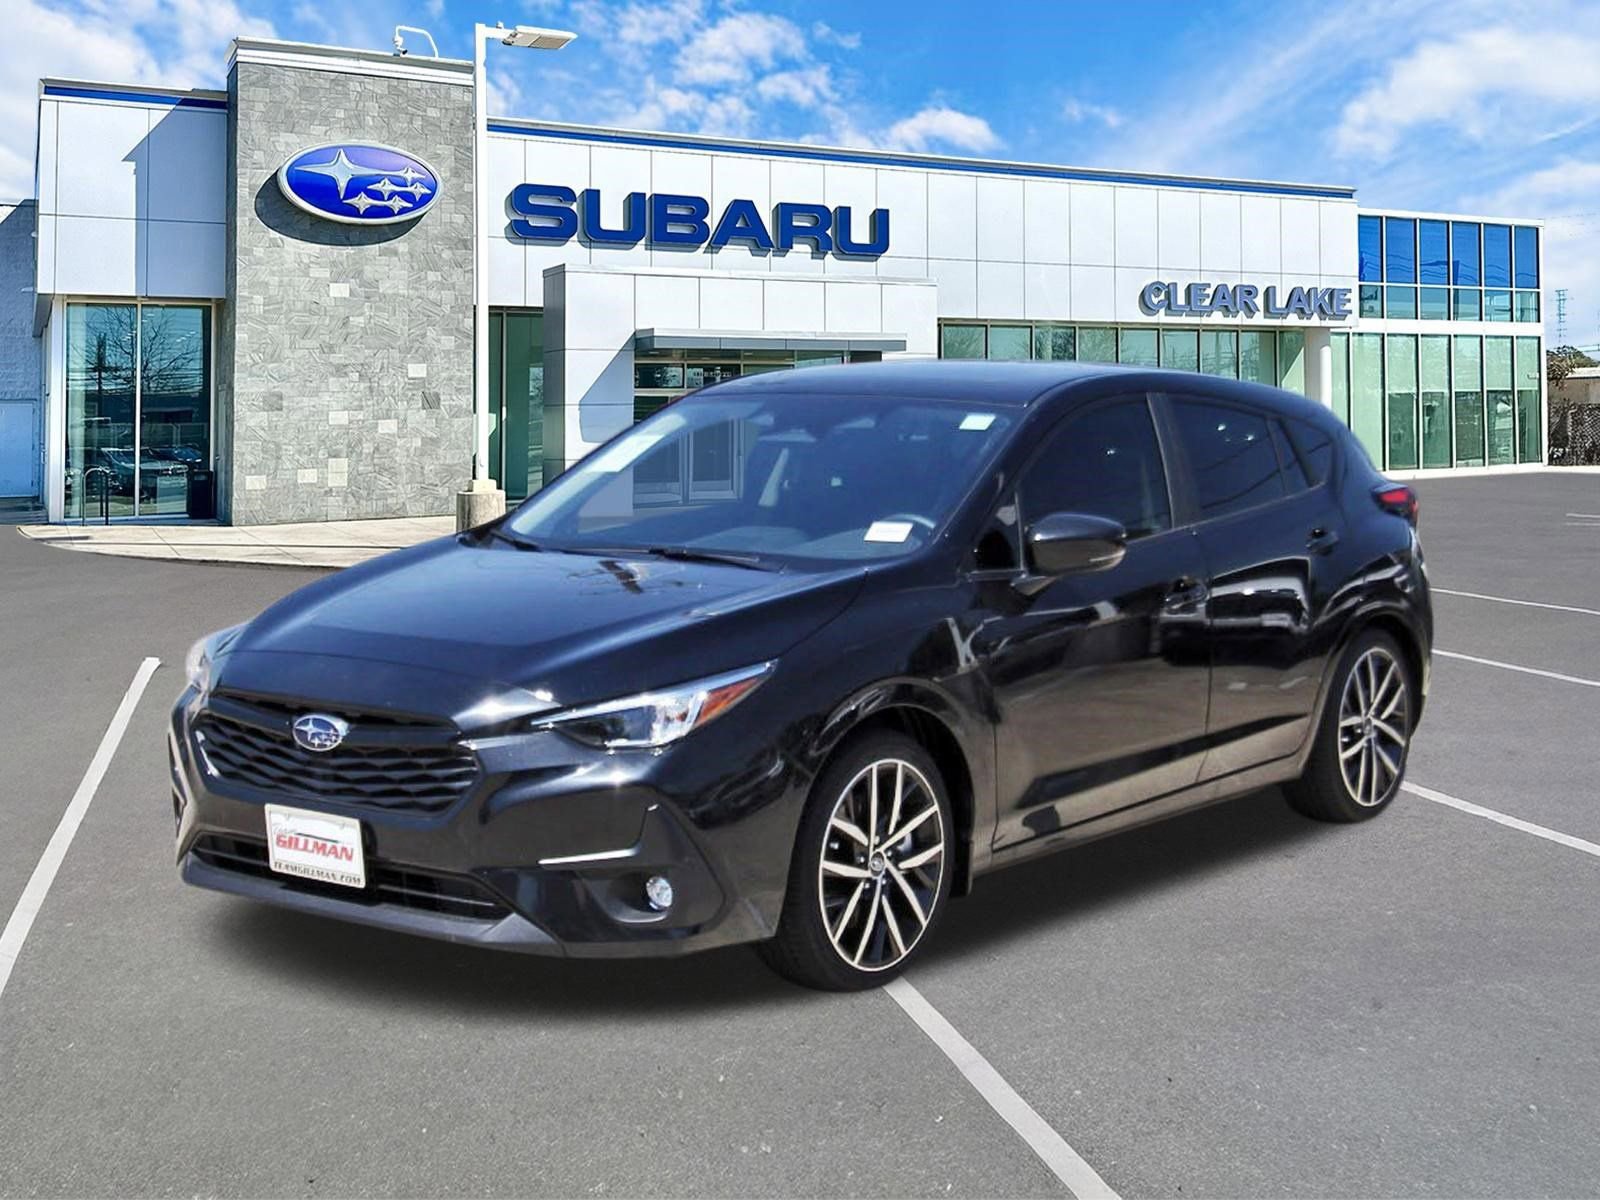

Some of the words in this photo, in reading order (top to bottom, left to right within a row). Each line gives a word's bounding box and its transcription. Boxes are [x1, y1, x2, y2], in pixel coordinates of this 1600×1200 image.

[506, 183, 889, 259] SUBARU
[1140, 281, 1260, 318] CLEAR
[1264, 286, 1352, 320] LAKE
[276, 833, 354, 861] GILLMAN
